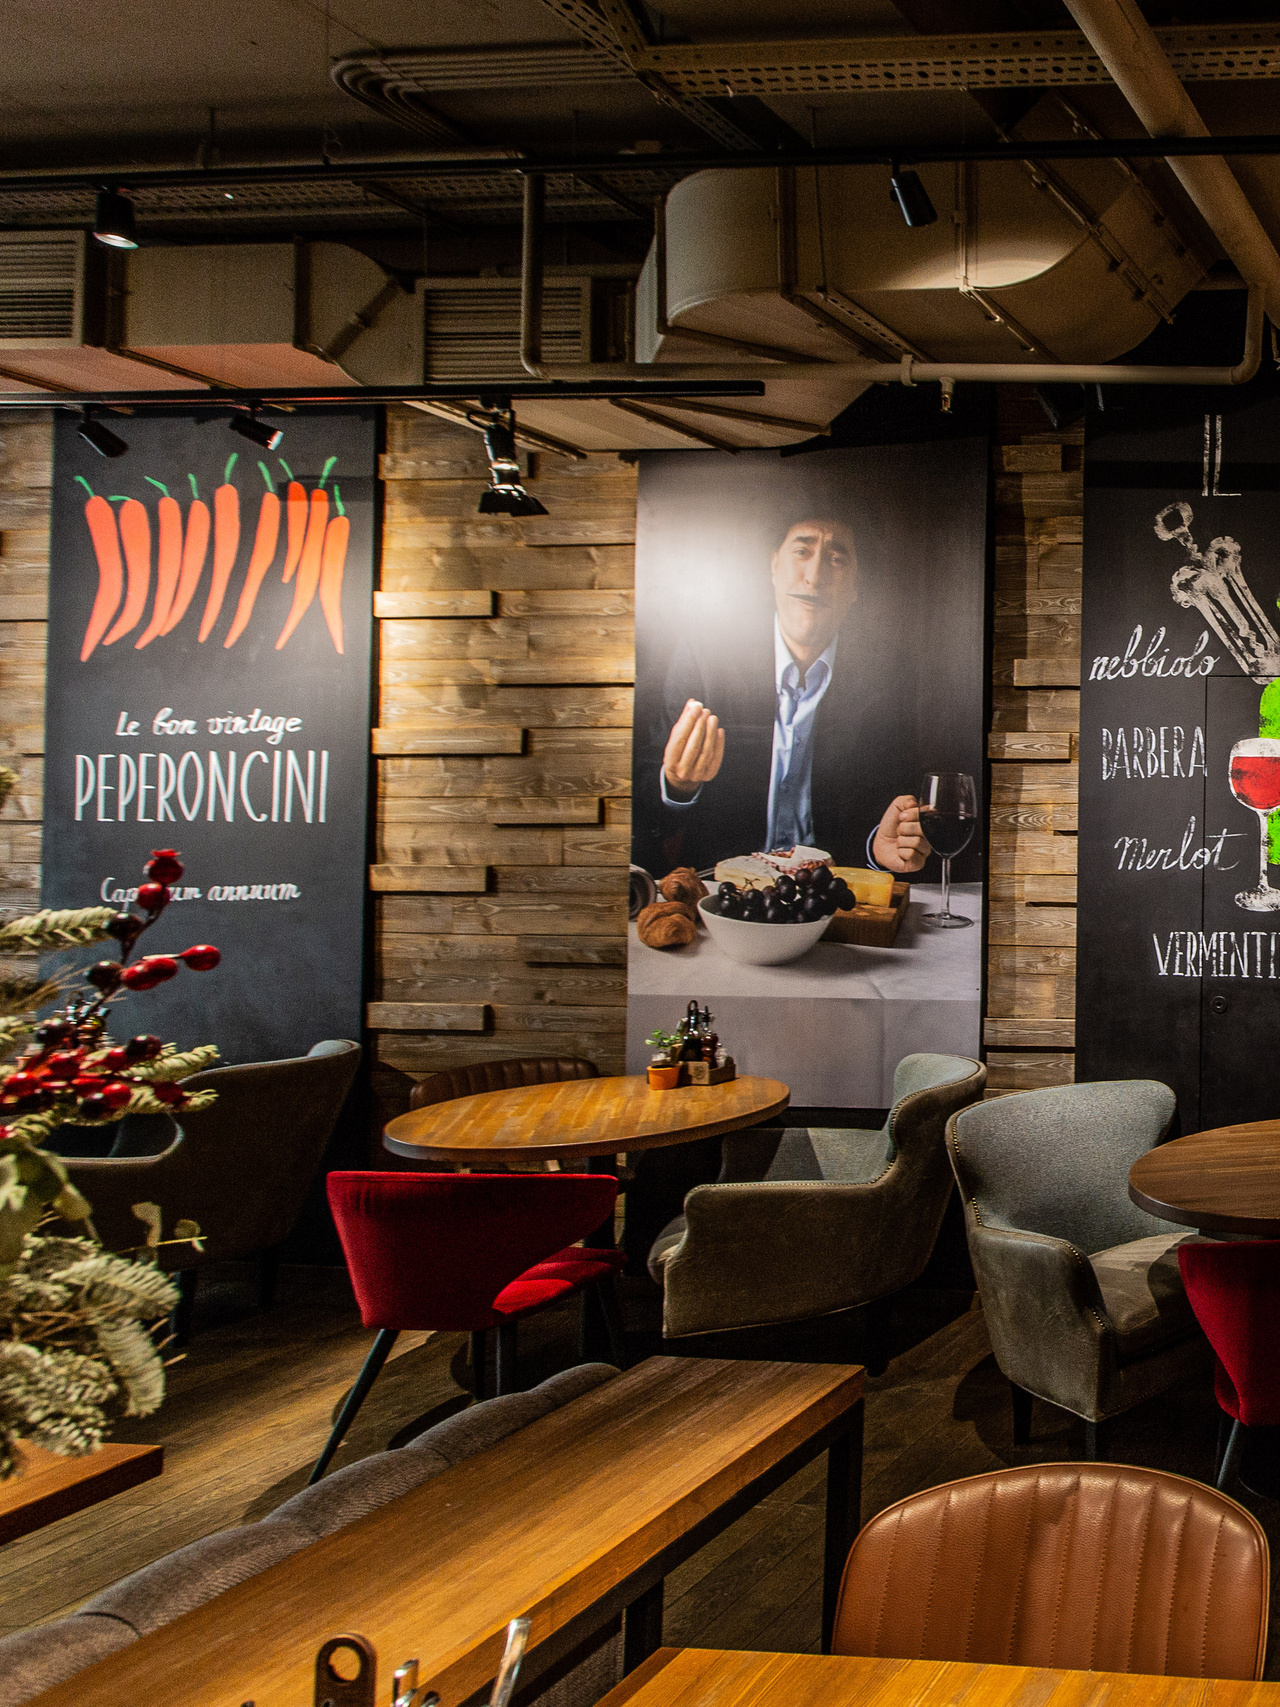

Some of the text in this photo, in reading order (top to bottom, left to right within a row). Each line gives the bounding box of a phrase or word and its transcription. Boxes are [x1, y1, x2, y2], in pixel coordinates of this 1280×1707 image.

[1201, 414, 1242, 497] IL
[1088, 624, 1221, 681] nebbiolo
[115, 707, 303, 745] Le bon vintage
[1101, 725, 1208, 781] BARBERA
[74, 750, 329, 823] PEPERONCINI
[100, 877, 302, 913] Capum annuum
